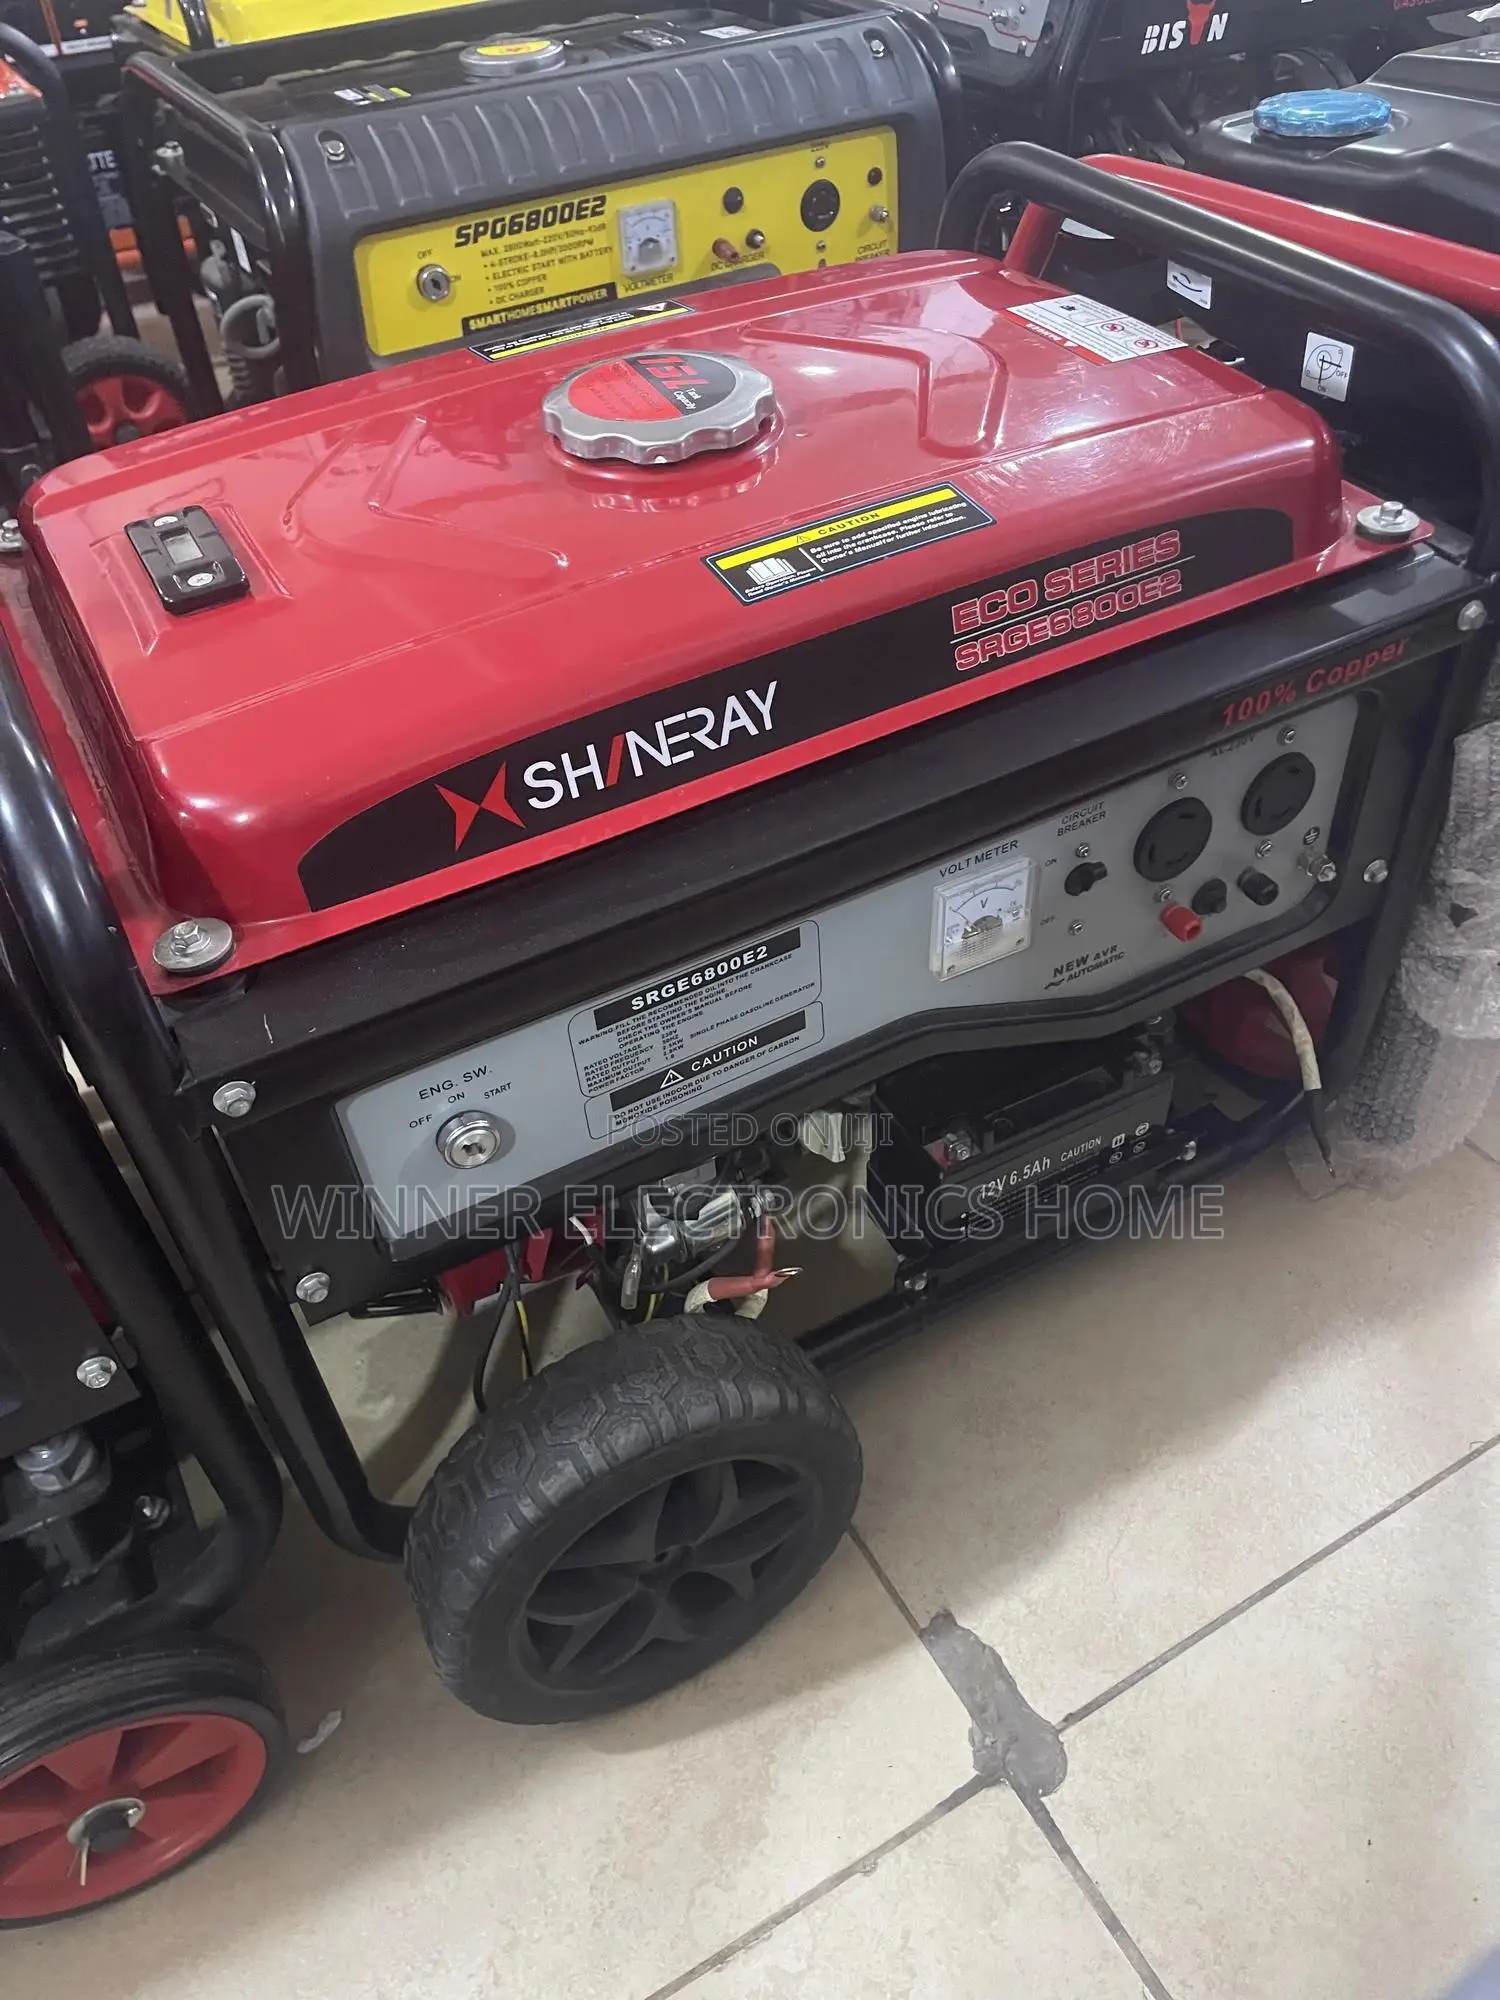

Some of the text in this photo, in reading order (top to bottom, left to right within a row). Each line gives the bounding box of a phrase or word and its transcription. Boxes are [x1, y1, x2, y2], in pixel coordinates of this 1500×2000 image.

[492, 246, 613, 280] ELECTRIC START WITH BATTERY
[517, 273, 547, 284] COPPER
[508, 286, 545, 301] CHARGER
[1317, 384, 1327, 393] ON
[1335, 370, 1348, 379] OFF
[673, 390, 696, 410] Capacity
[810, 501, 967, 554] Be sure to add specified engine lubricating
[815, 551, 826, 560] oil
[826, 547, 842, 556] into
[843, 541, 857, 551] the
[899, 521, 926, 533] Please
[926, 515, 944, 524] refer
[817, 512, 881, 536] CAUTION
[820, 550, 853, 564] Owner's
[895, 528, 921, 541] further
[922, 515, 967, 532] information.
[951, 529, 1180, 635] ECO SERIES
[954, 569, 1183, 672] SRGE6800E2
[1221, 635, 1411, 728] 100% Copper
[522, 680, 778, 810] SHINERAY
[1056, 810, 1107, 837] BREAKER
[1061, 801, 1105, 825] CIRCUIT
[939, 839, 1019, 878] VOLT METER
[1044, 857, 1057, 868] ON
[980, 896, 989, 909] V
[1039, 915, 1056, 927] OFF
[1052, 944, 1118, 978] NEW AVR
[1066, 951, 1126, 983] AUTOMATIC
[631, 945, 769, 1011] SRGE6800E2
[632, 1014, 647, 1023] THE
[648, 989, 704, 1018] RECOMMENDED
[705, 985, 716, 993] OIL
[717, 978, 734, 989] INTO
[735, 972, 749, 981] THE
[750, 953, 792, 975] CRANKCASE
[616, 1020, 646, 1037] BEFORE
[647, 1006, 683, 1024] STARTING
[684, 1000, 698, 1010] THE
[617, 983, 753, 1043] CHECK THE OWNER'S MANUAL BEFORE
[690, 982, 815, 1039] SINGLE PHASE GASOLINE GENERATOR
[618, 1010, 703, 1049] OPERATING THE ENGINE
[583, 1057, 608, 1071] RATED
[608, 1044, 642, 1061] VOLTAGE
[584, 1063, 609, 1077] RATED
[610, 1045, 654, 1067] FREQUENCY
[586, 1068, 610, 1082] RATED
[611, 1055, 640, 1072] OUTPUT
[690, 1035, 759, 1072] CAUTION
[418, 1065, 493, 1100] ENG. SW.
[587, 1069, 621, 1088] MAXIMUM
[622, 1057, 651, 1073] OUTPUT
[588, 1080, 614, 1094] POWER
[615, 1067, 645, 1082] FACTOR
[614, 1035, 800, 1120] DO NOT USE INDOOR DUE TO DANGER OF CARBON
[447, 1092, 465, 1104] ON
[483, 1082, 513, 1100] START
[615, 1085, 703, 1126] MONOXIDE POISONING
[409, 1114, 433, 1129] OFF
[1060, 1136, 1102, 1162] CAUTION
[979, 1175, 1008, 1199] 12V
[1009, 1157, 1050, 1186] 6.5Ah
